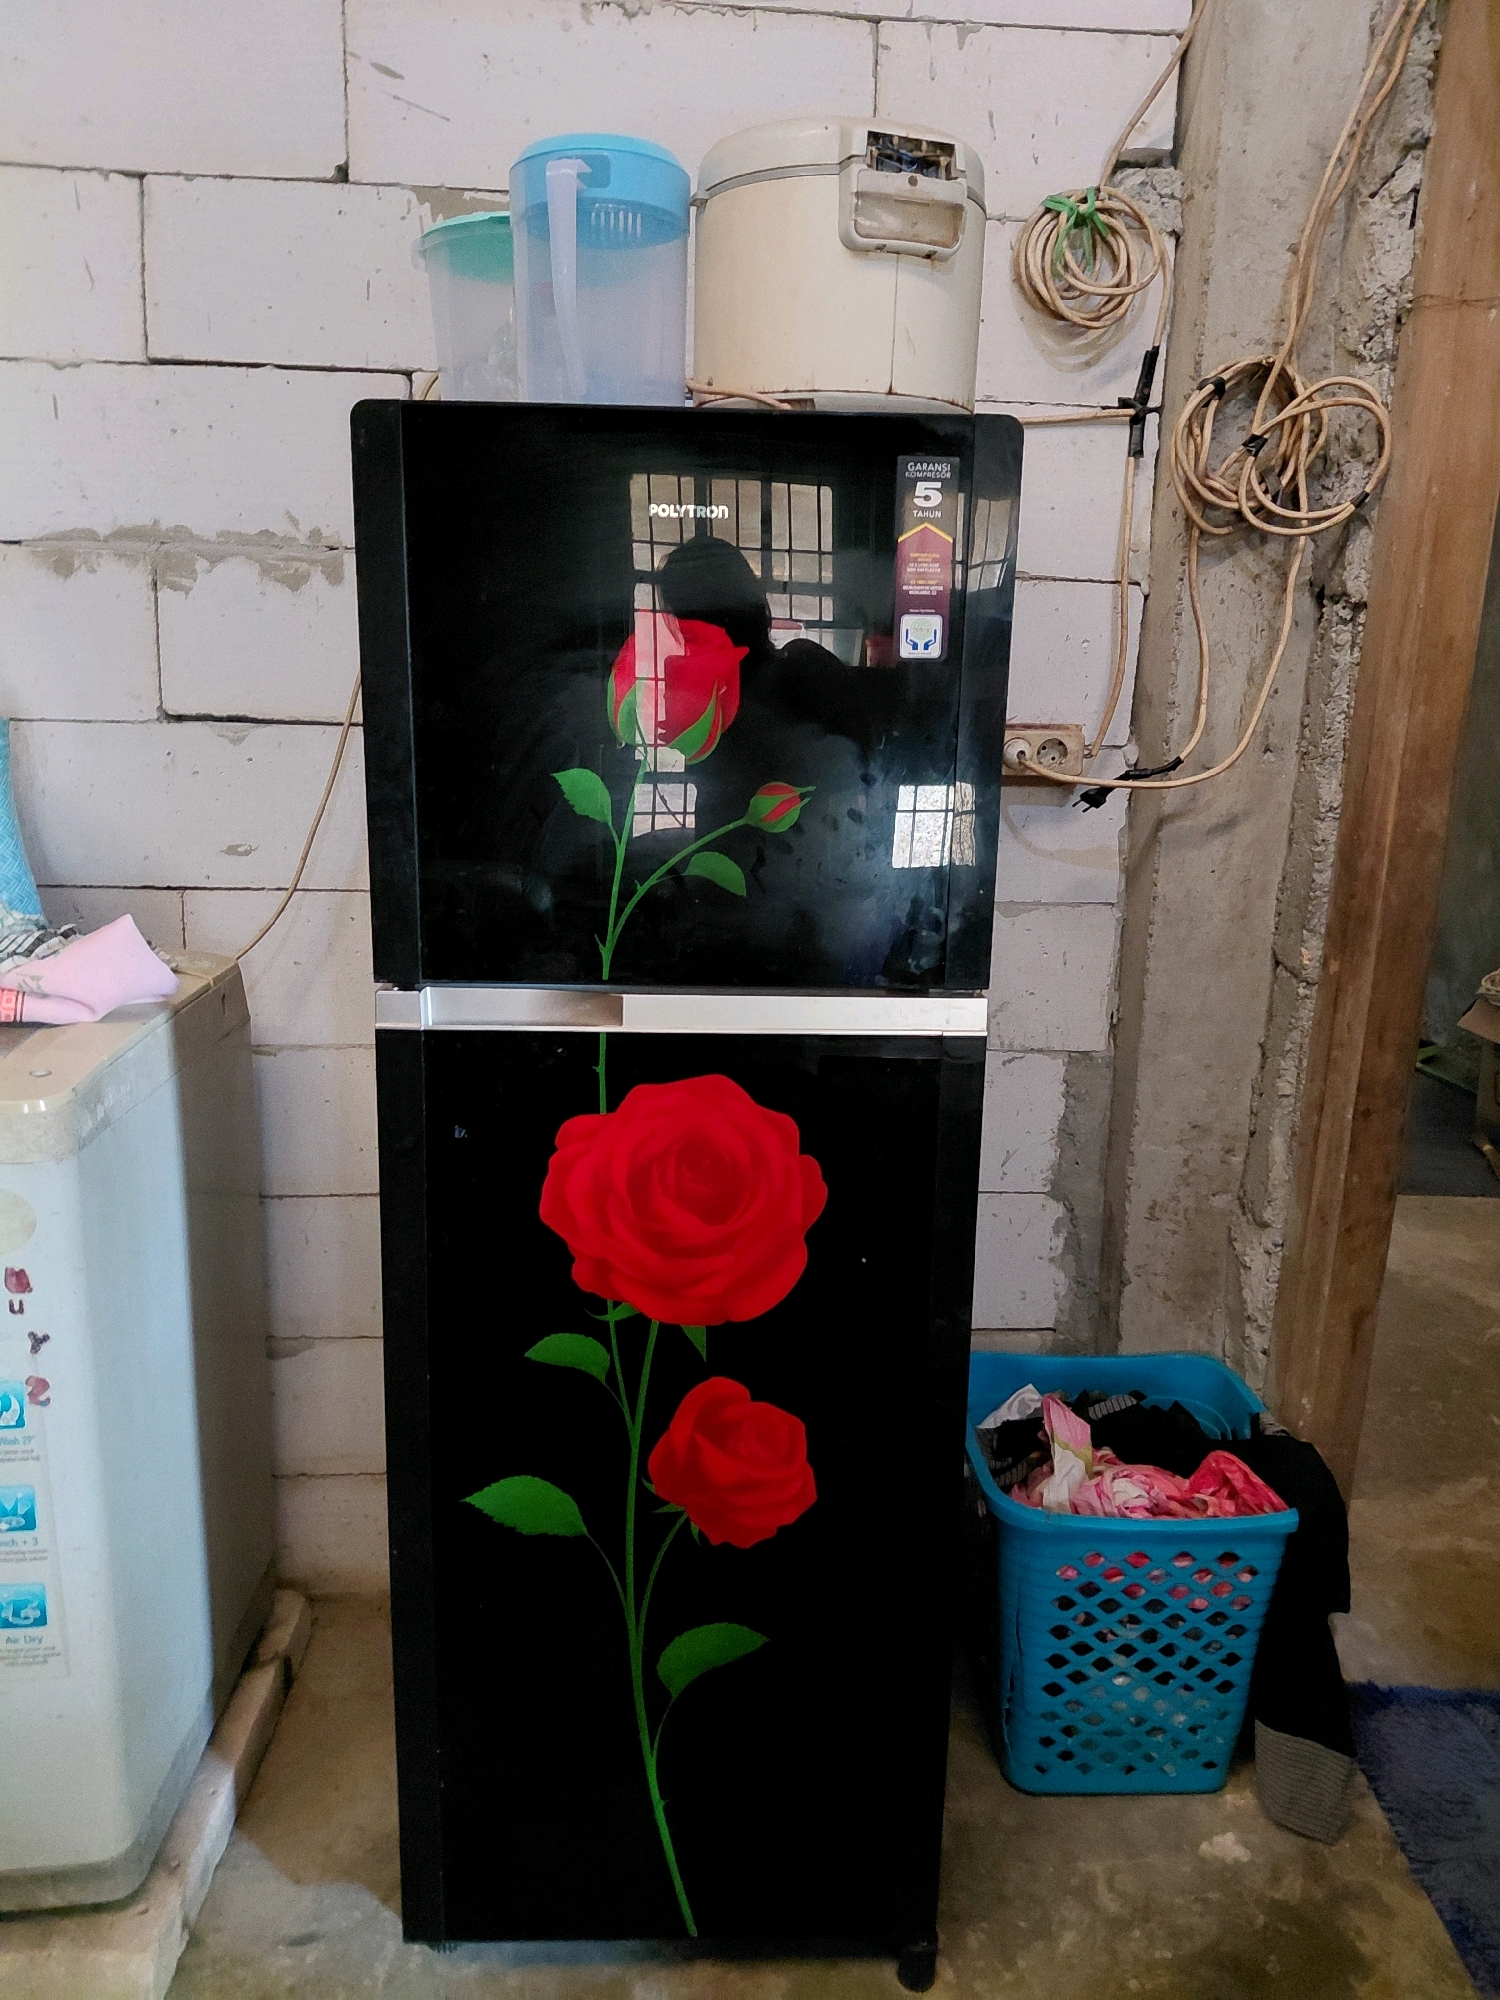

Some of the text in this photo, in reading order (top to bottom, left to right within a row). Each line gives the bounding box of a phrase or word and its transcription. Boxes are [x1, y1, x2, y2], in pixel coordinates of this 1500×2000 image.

[907, 462, 951, 471] GARANSI
[905, 471, 952, 479] KOMPRESOR
[913, 481, 943, 508] 5
[913, 510, 942, 518] TAHUN
